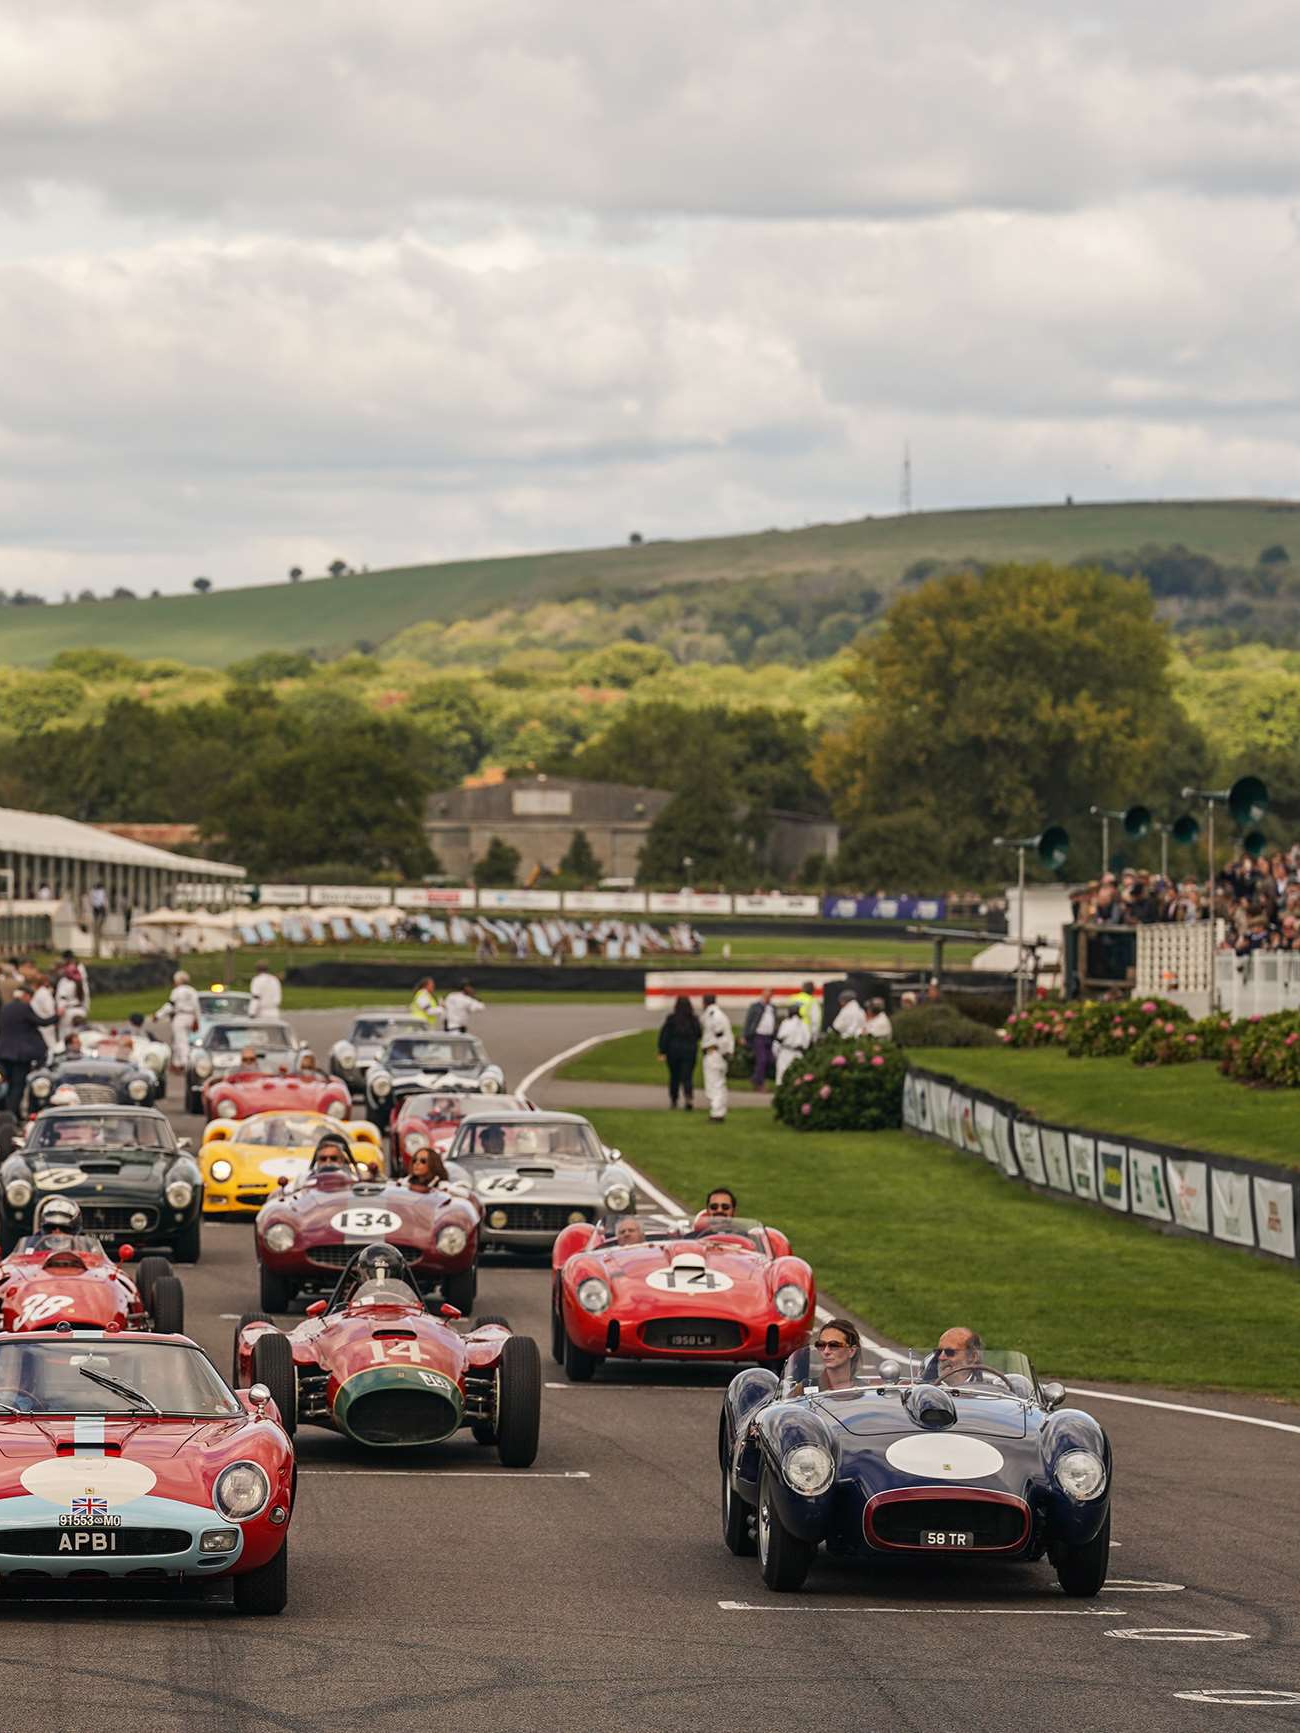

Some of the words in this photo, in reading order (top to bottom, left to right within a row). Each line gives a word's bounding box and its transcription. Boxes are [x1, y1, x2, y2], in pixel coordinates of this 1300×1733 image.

[37, 1170, 77, 1185] 16
[486, 1177, 522, 1192] 14
[340, 1212, 393, 1228] 134
[660, 1268, 721, 1290] 14
[12, 1292, 76, 1332] 38
[366, 1339, 431, 1364] 14
[927, 1532, 946, 1545] 58
[948, 1533, 966, 1546] TR
